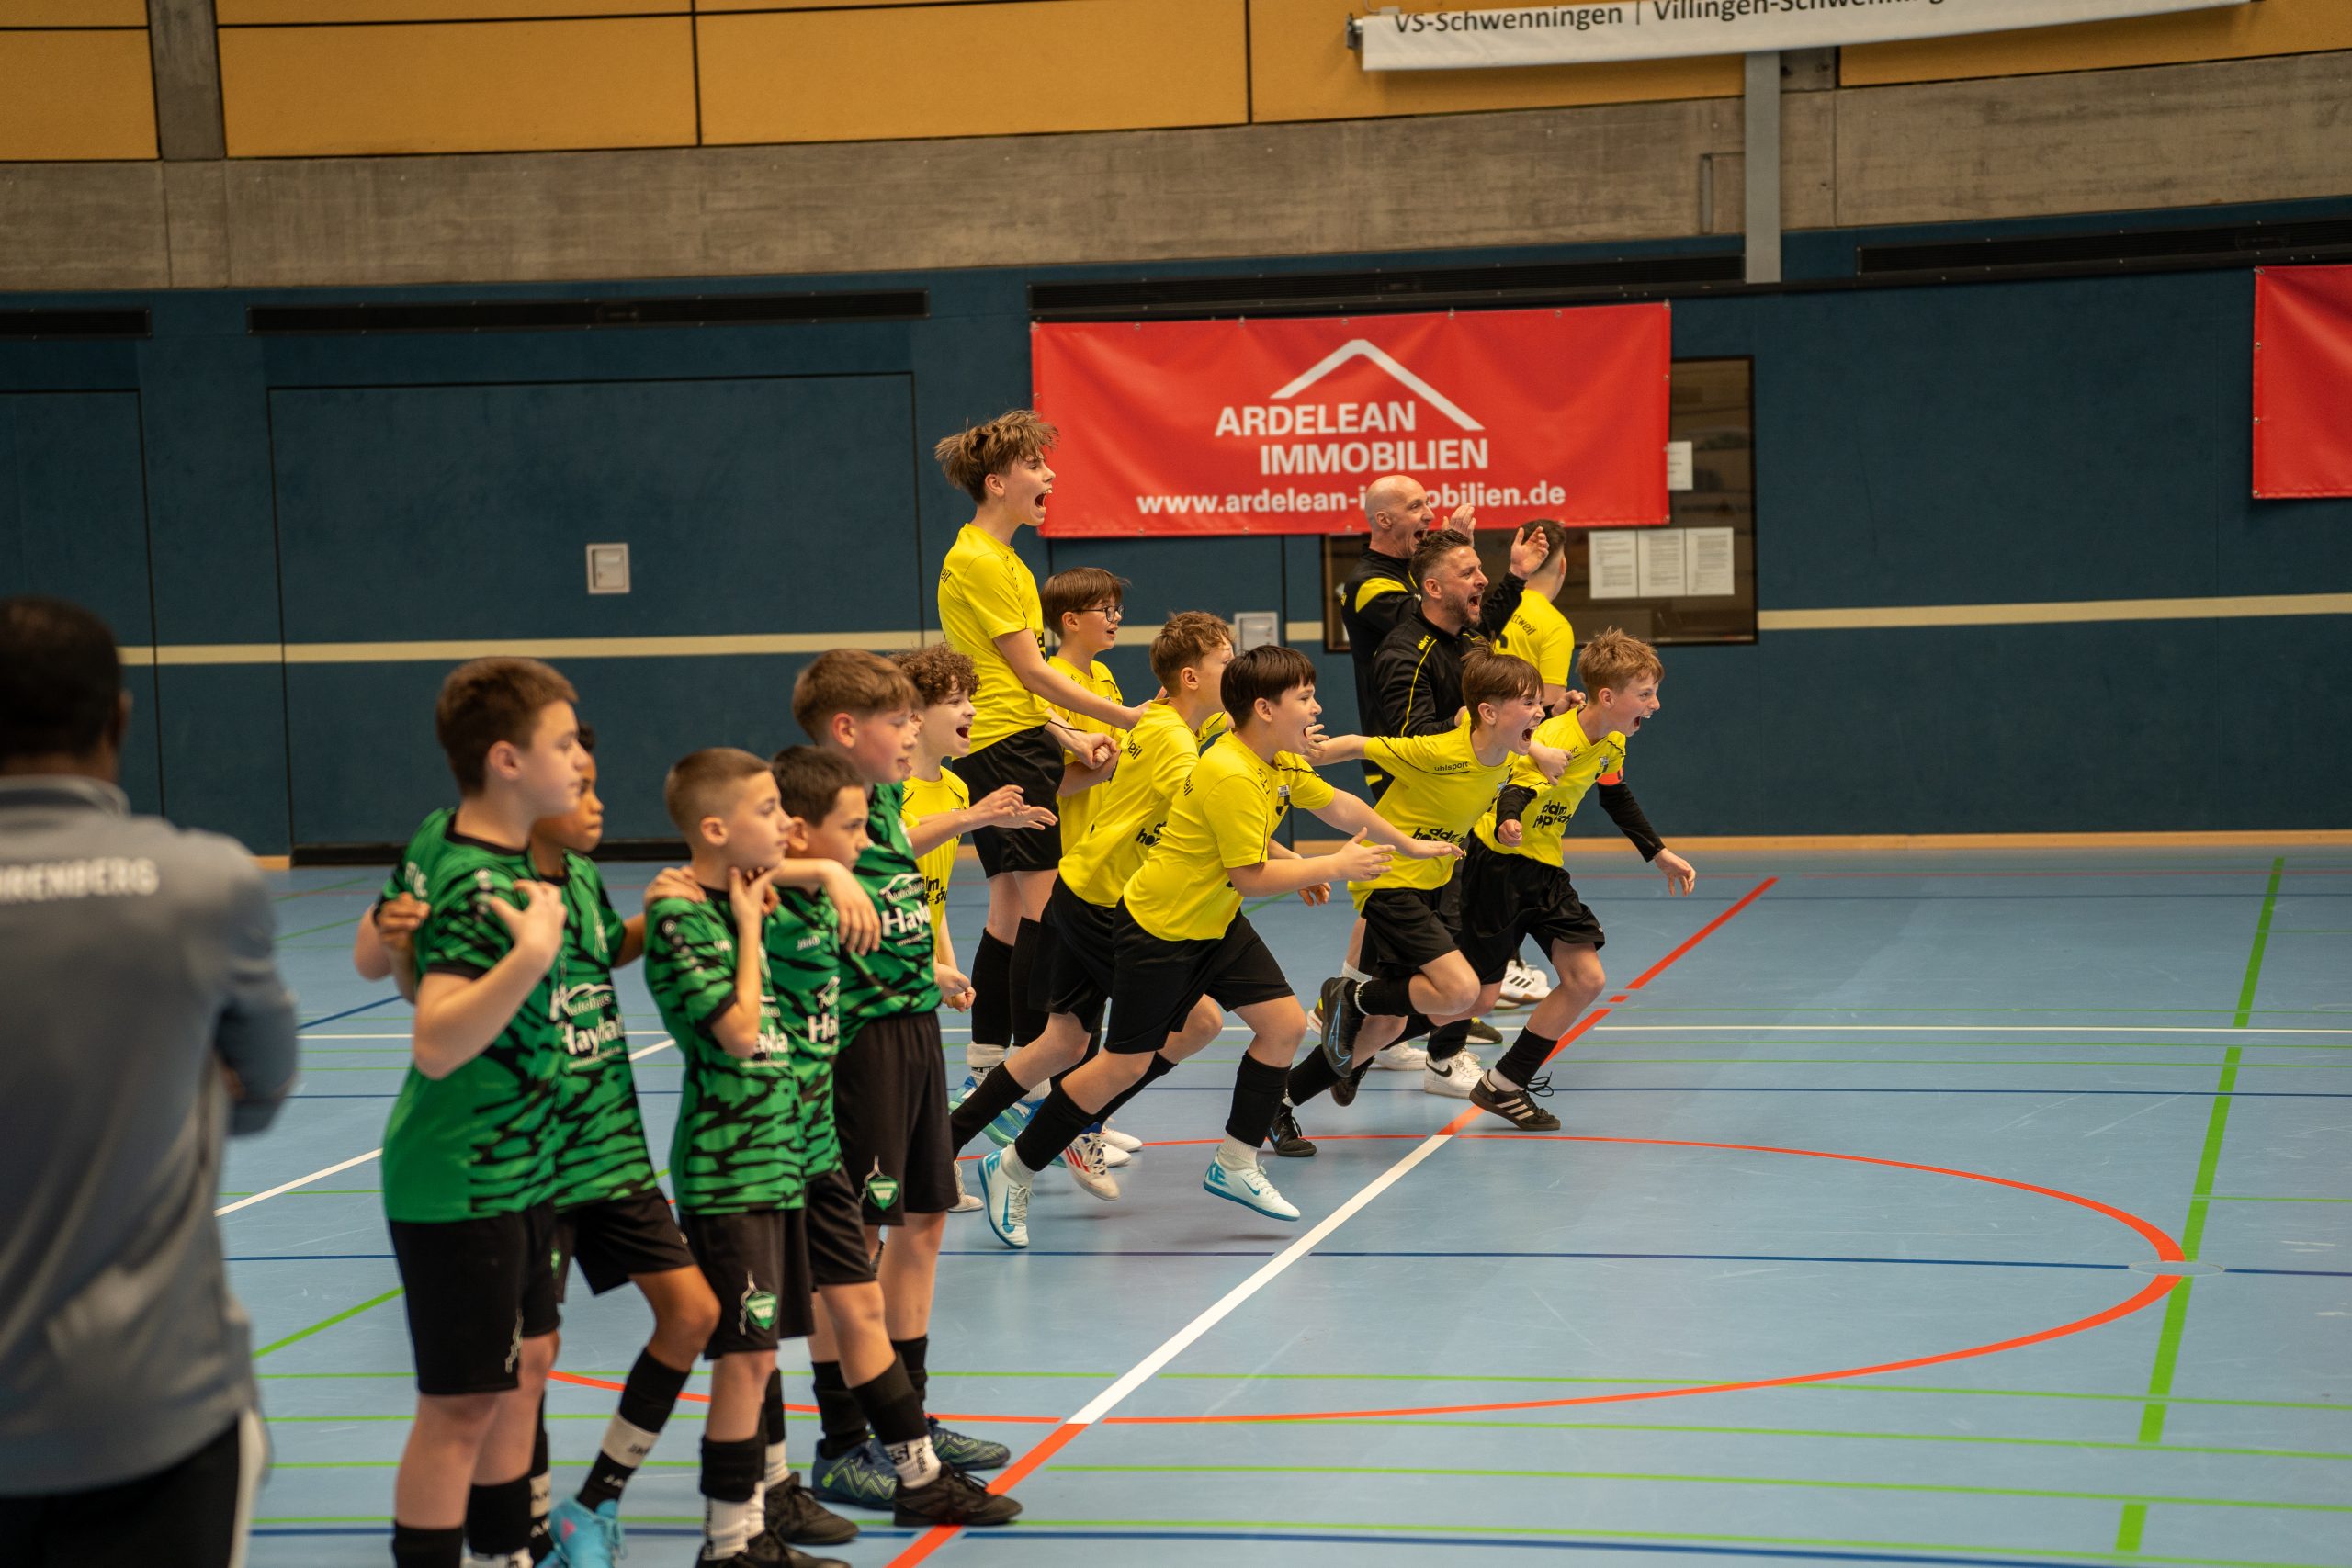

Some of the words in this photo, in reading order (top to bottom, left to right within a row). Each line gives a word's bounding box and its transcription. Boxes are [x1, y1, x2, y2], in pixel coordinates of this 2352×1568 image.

[1394, 6, 1623, 33] VS-Schwenningen
[1215, 401, 1416, 437] ARDELEAN
[1260, 438, 1488, 475] IMMOBILIEN
[1136, 481, 1566, 514] www.ardelean-iobilien.de
[1434, 761, 1469, 772] uhlsport
